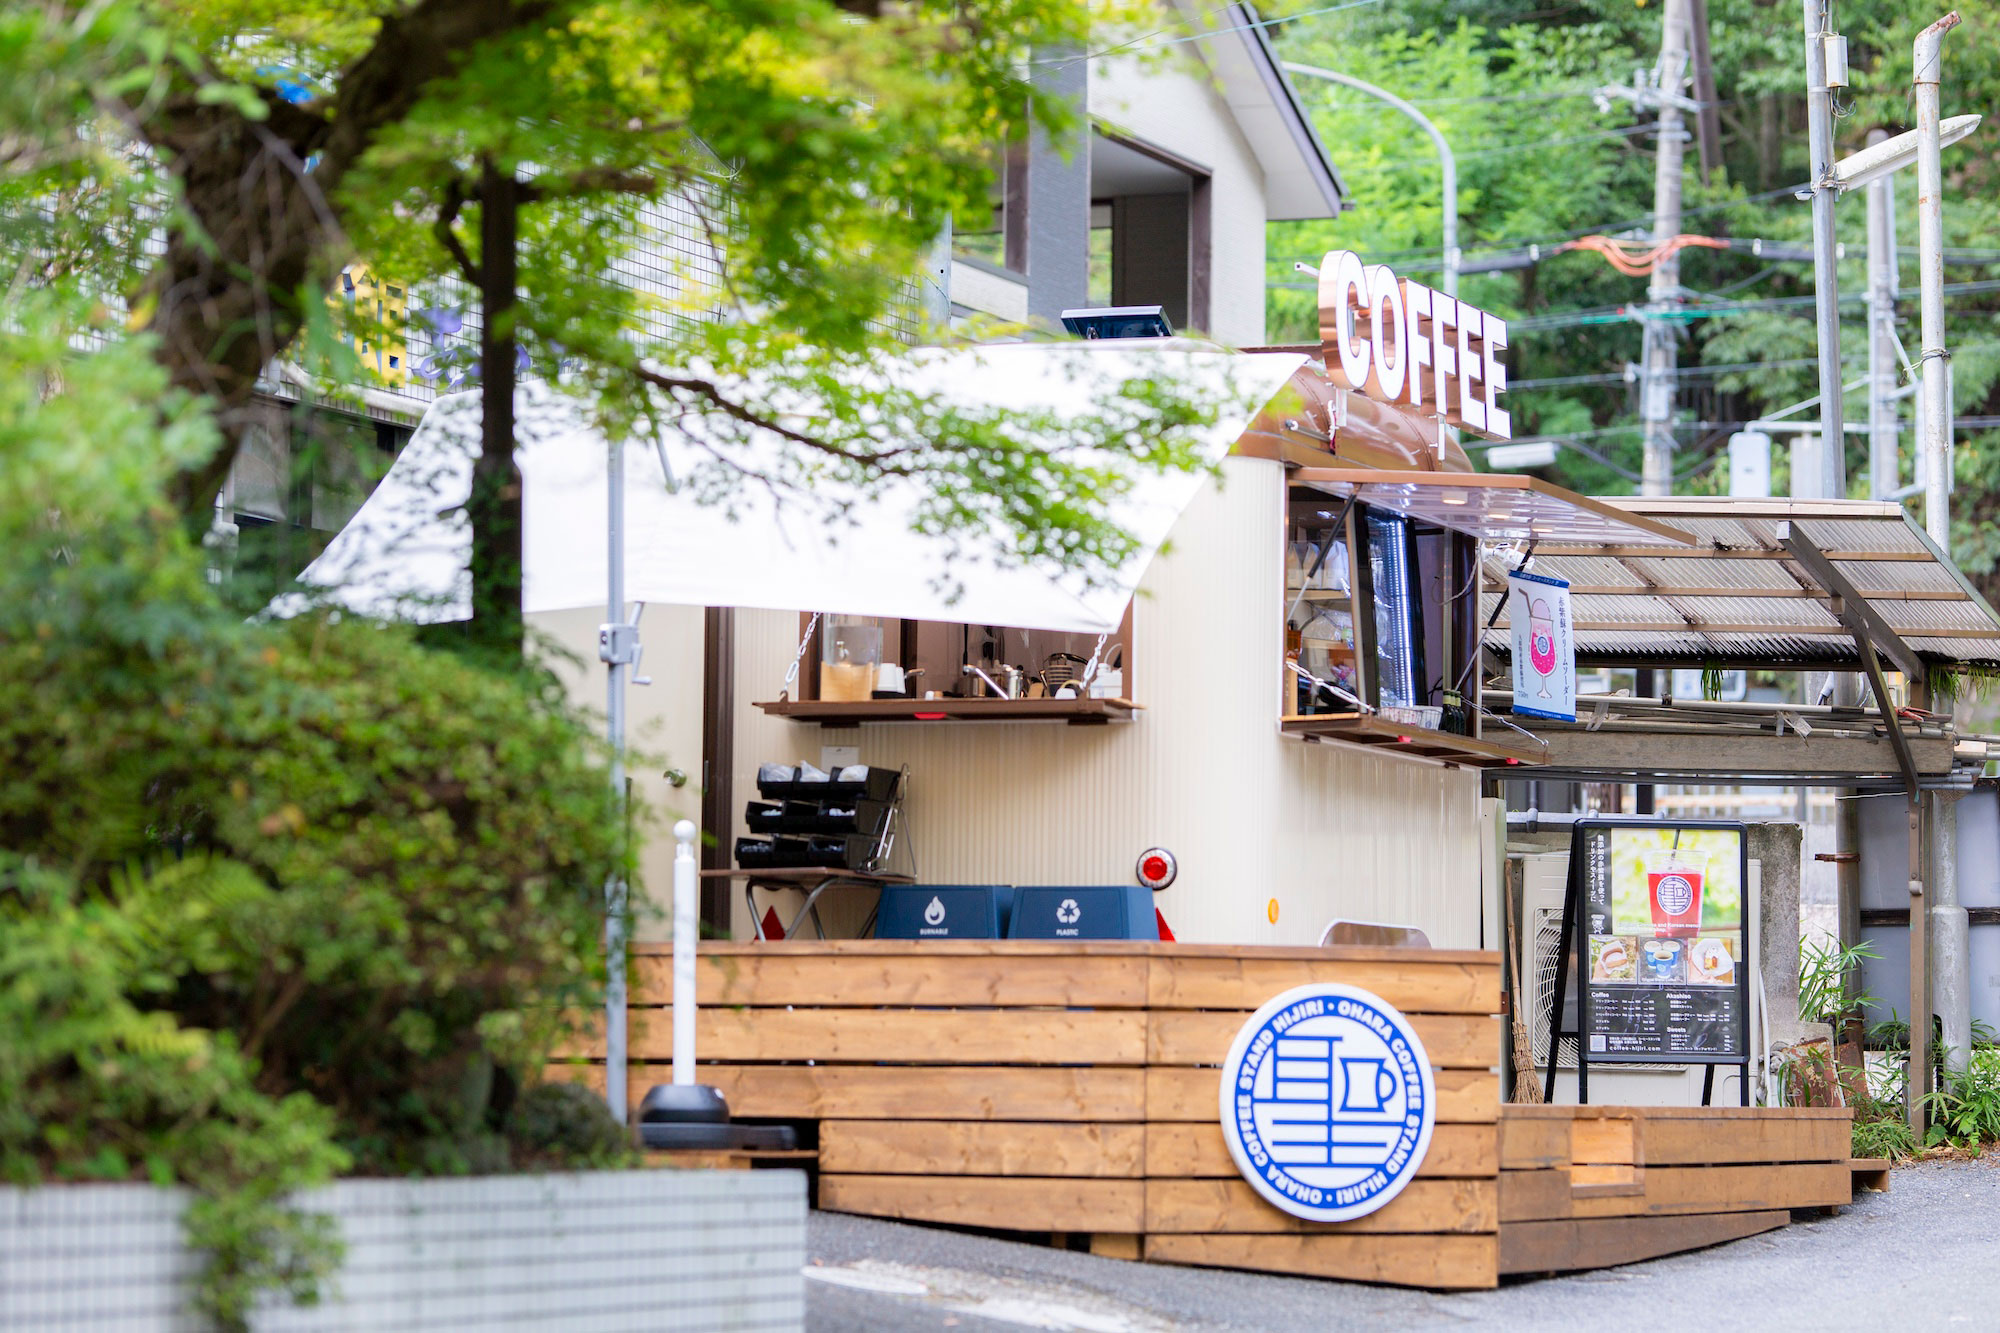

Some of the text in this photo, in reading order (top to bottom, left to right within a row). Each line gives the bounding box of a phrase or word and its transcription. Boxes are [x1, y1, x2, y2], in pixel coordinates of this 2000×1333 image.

[1322, 250, 1511, 439] COFFEE
[1238, 1000, 1324, 1205] OHARA COFFEE STAND HIJIRI
[1336, 1000, 1422, 1205] OHARA COFFEE STAND HIJIRI
